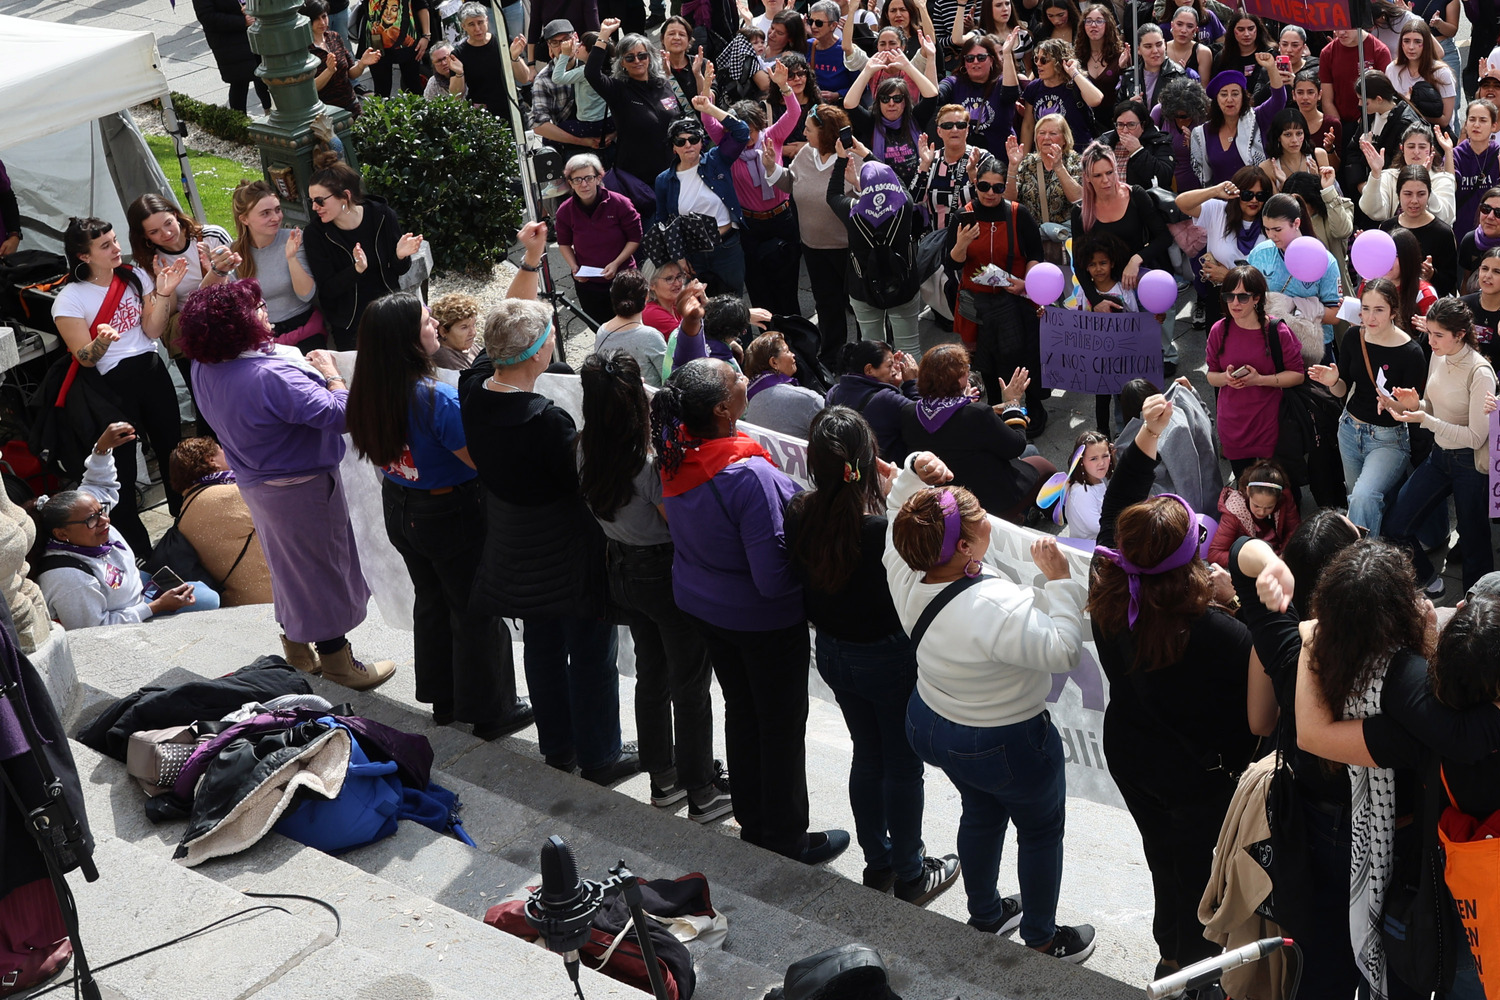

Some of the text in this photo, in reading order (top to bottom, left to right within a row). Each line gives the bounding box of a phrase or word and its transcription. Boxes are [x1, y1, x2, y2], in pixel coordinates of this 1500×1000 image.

[1044, 310, 1141, 333] NOS SEMBRARON
[1064, 330, 1115, 352] MIEDO
[1046, 352, 1157, 376] Y NOS CRECIERON
[1070, 372, 1123, 394] ALAS
